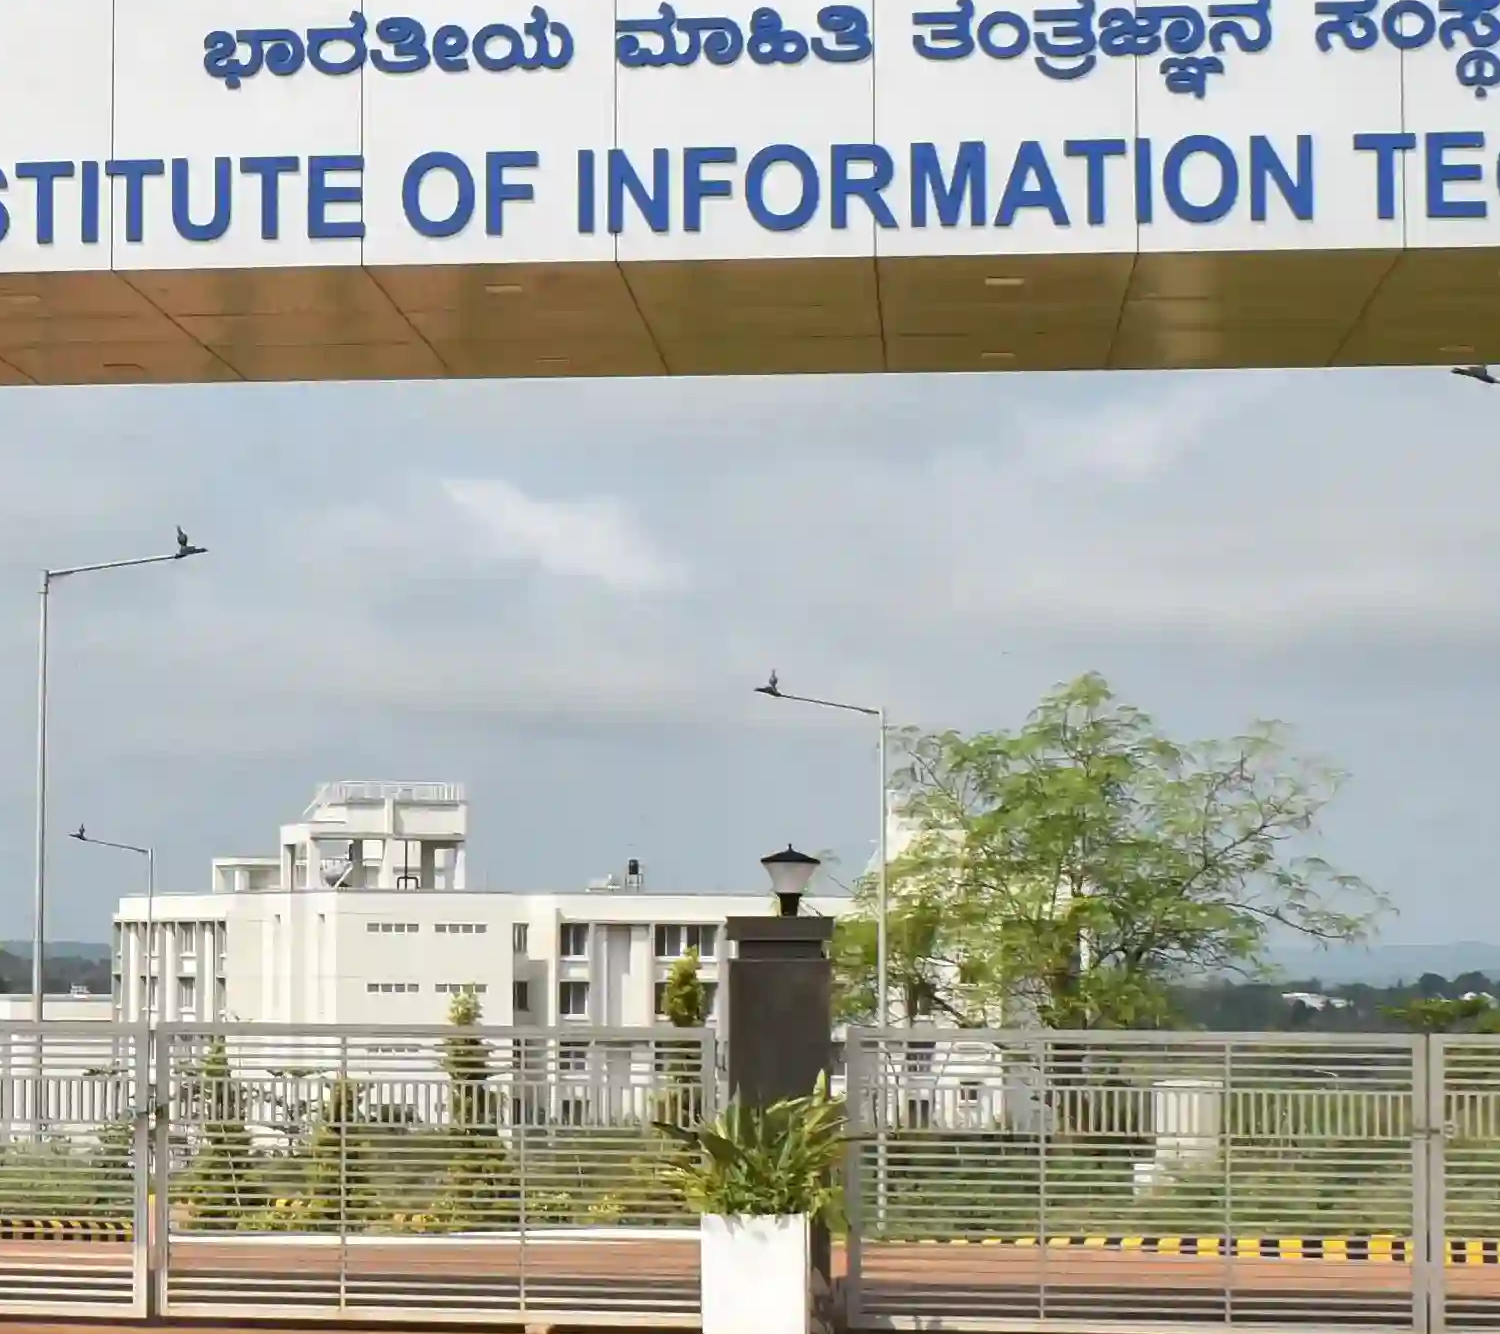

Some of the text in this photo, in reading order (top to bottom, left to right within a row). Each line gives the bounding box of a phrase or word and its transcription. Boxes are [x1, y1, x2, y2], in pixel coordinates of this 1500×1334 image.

[204, 6, 575, 88] ಭಾರತೀಯ
[614, 1, 875, 69] ಮಾಹಿತಿ
[402, 149, 542, 239] OF
[577, 134, 1320, 233] INFORMATION
